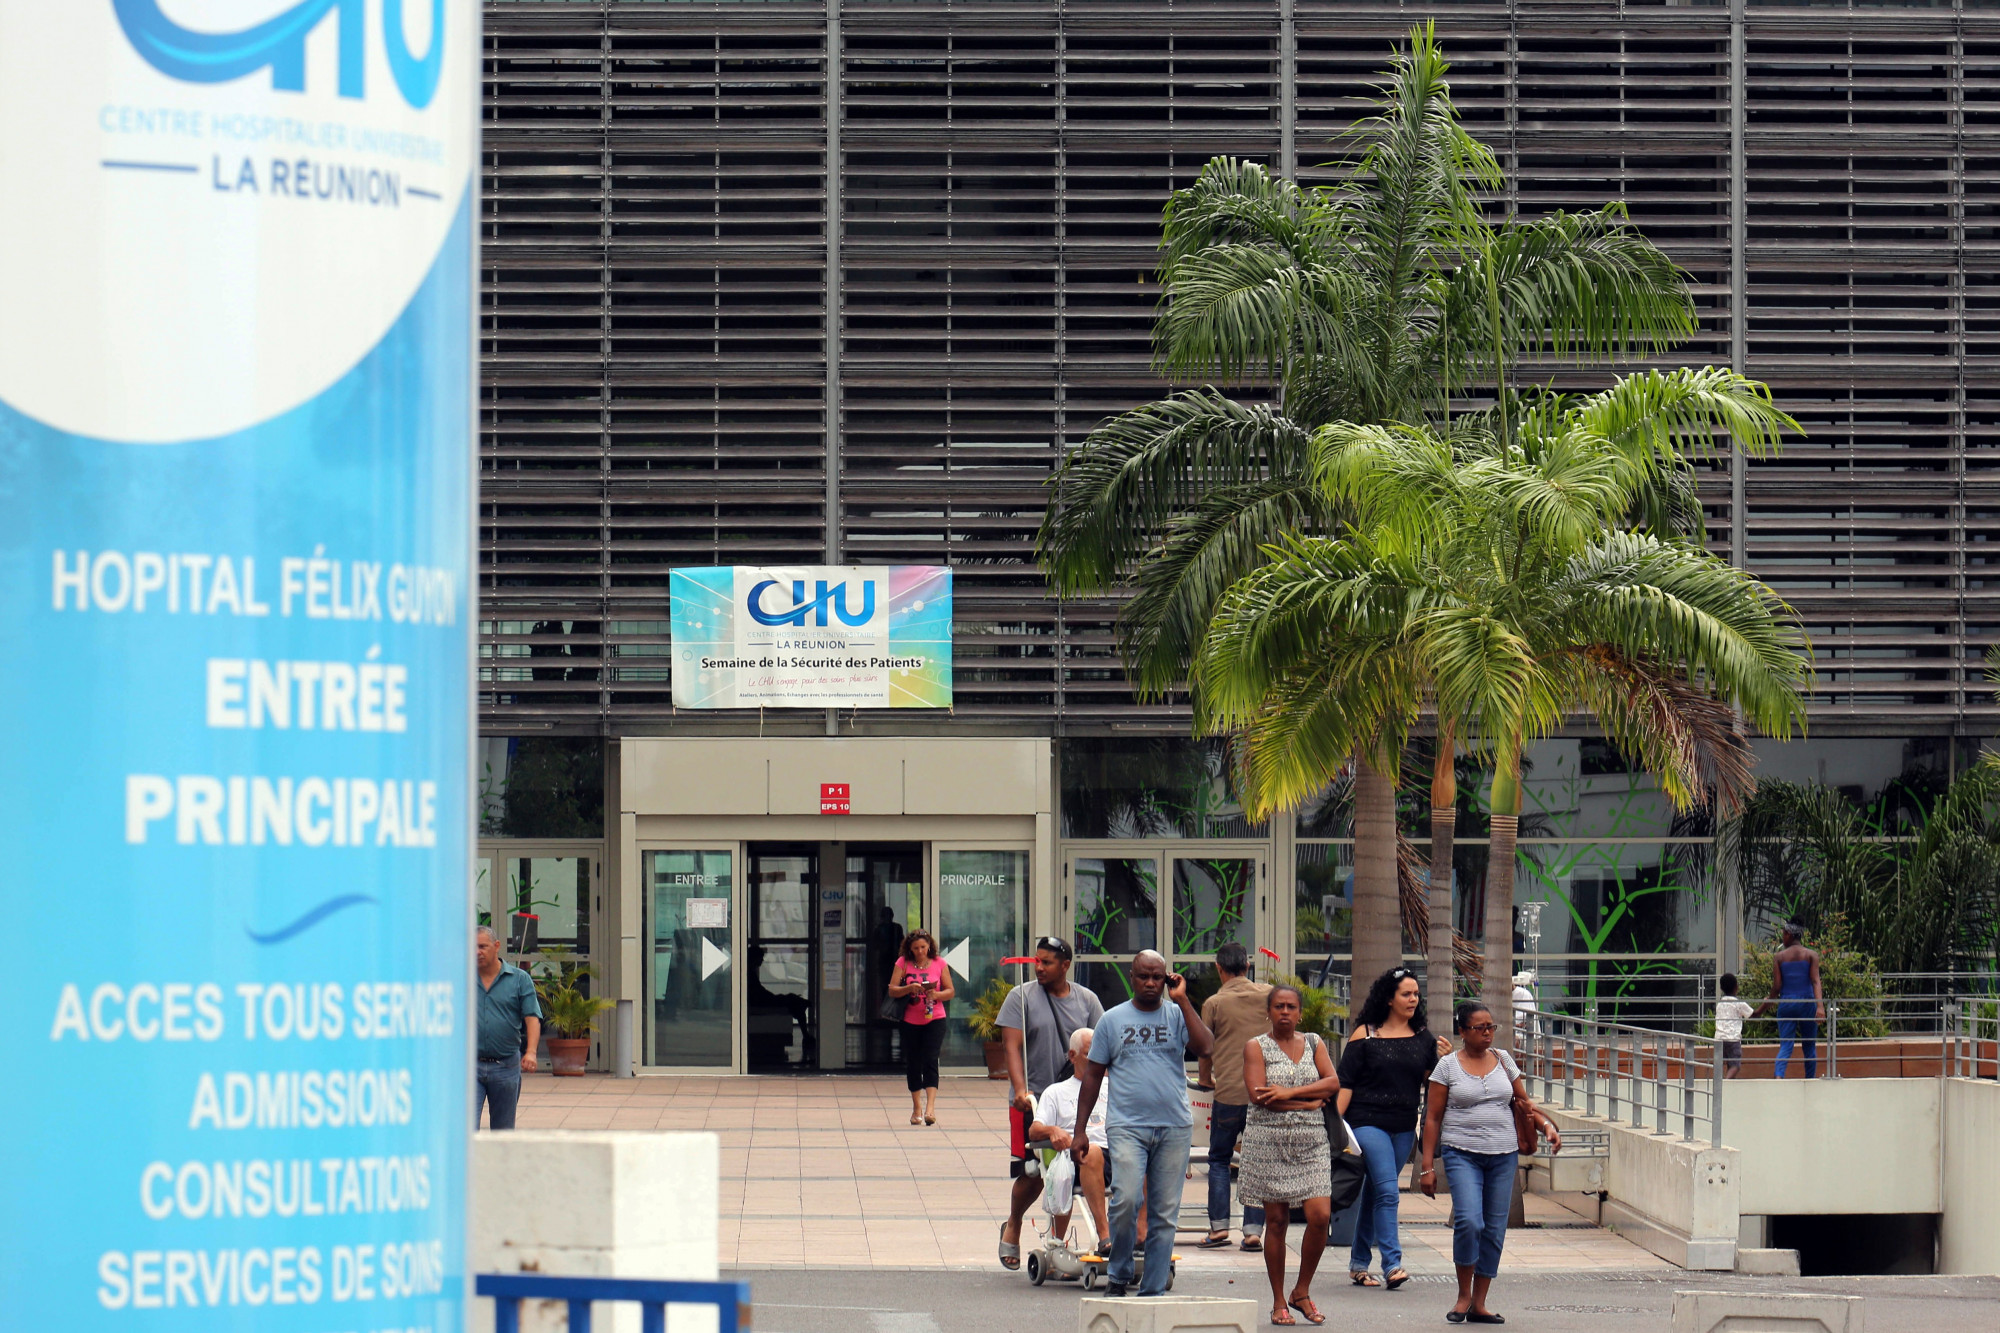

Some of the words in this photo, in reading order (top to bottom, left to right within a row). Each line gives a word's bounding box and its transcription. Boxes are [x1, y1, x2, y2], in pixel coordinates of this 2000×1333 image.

[99, 104, 205, 138] CENTRE
[212, 153, 259, 194] LA
[270, 156, 401, 207] RÉUNION
[52, 549, 270, 617] HOPITAL
[280, 543, 382, 621] FÉLIX
[747, 580, 875, 627] CHU
[701, 657, 756, 669] Semaine
[759, 656, 774, 668] de
[777, 656, 787, 668] la
[791, 656, 843, 668] Sécurité
[845, 656, 867, 668] des
[870, 656, 922, 668] Patients
[777, 640, 791, 649] LA
[794, 639, 846, 649] RÉUNION
[206, 643, 408, 733] ENTRÉE
[125, 773, 437, 848] PRINCIPALE
[822, 803, 838, 811] EPS
[840, 803, 850, 811] 10
[828, 787, 835, 795] P
[838, 787, 842, 795] 1
[941, 874, 1005, 886] PRINCIPALE
[51, 982, 225, 1042] ACCES
[235, 982, 345, 1041] TOUS
[352, 981, 455, 1039] SERVICES
[189, 1069, 412, 1130] ADMISSIONS
[140, 1155, 431, 1220] CONSULTATIONS
[97, 1246, 322, 1310] SERVICES
[332, 1244, 375, 1301] DE
[381, 1240, 443, 1298] SOINS
